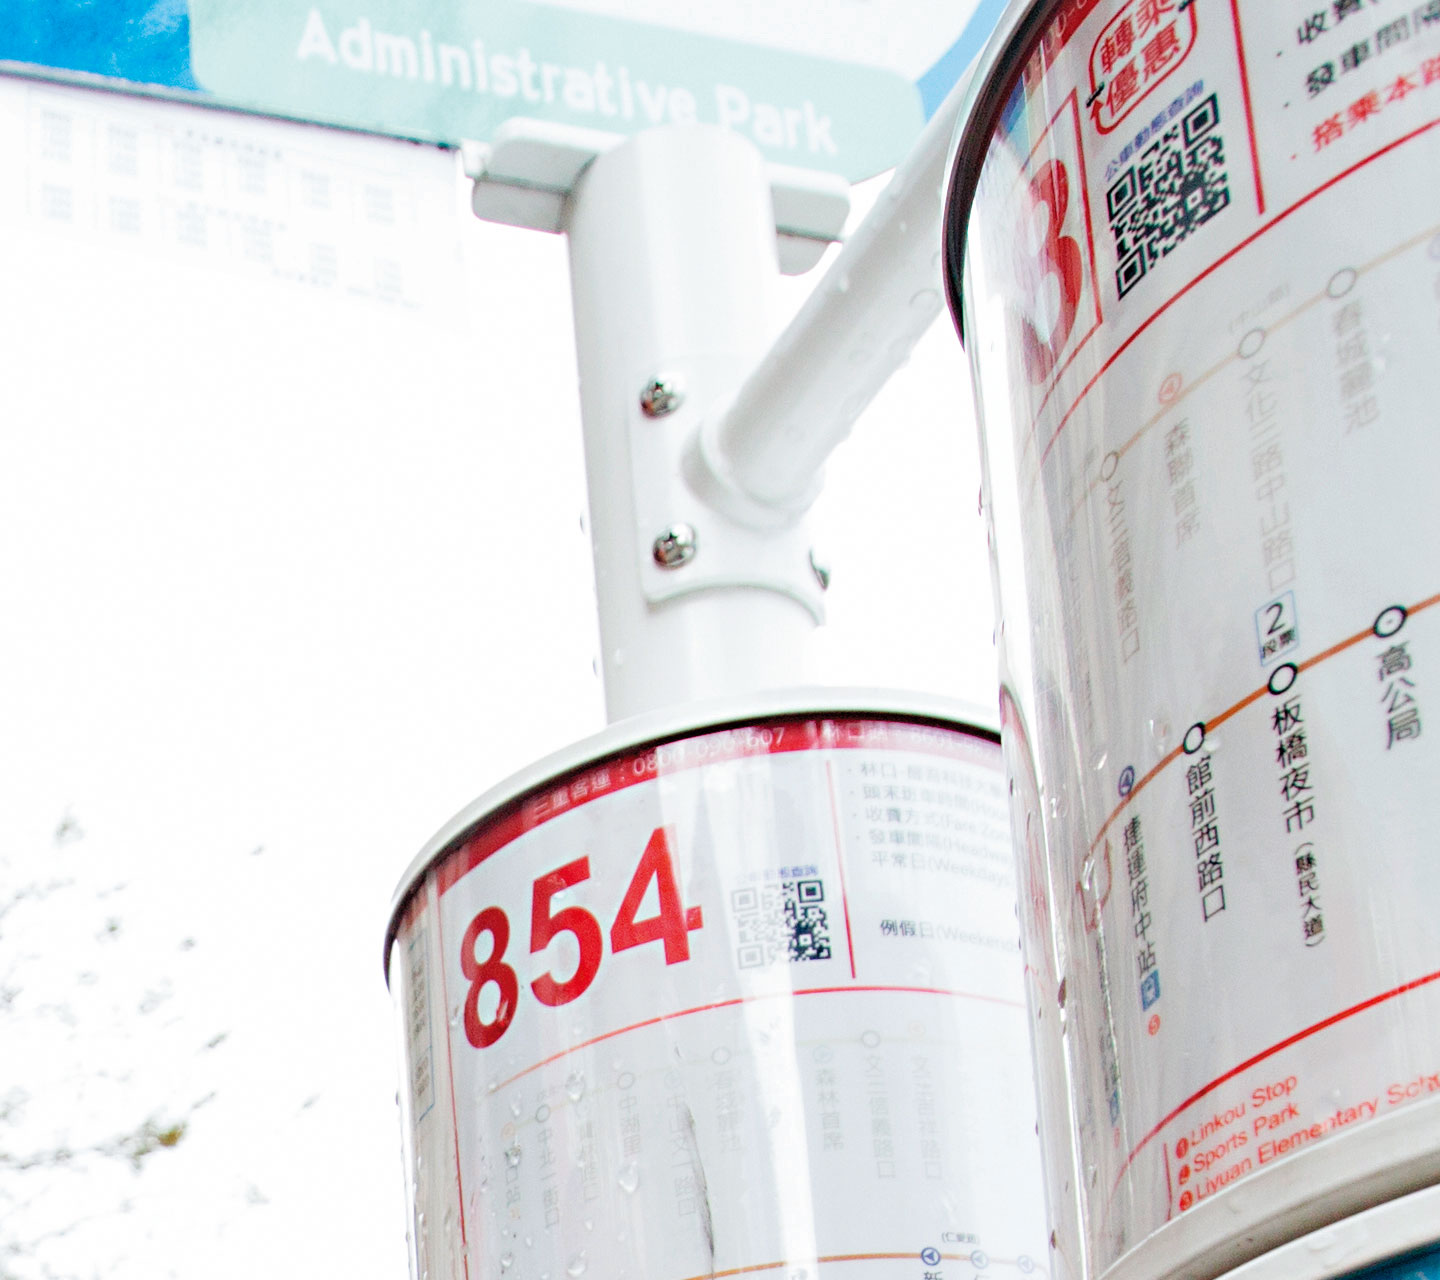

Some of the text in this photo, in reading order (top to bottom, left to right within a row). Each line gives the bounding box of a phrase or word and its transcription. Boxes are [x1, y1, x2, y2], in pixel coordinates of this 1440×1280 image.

[296, 6, 842, 157] Administrative Park
[1264, 601, 1288, 637] 2
[1372, 640, 1424, 752] 高公局
[1269, 693, 1317, 836] 板橋夜市
[1122, 815, 1158, 979] 捷運府中站
[1184, 755, 1228, 924] 館前西路口
[459, 823, 705, 1052] 854
[1188, 1072, 1299, 1146] Linkou Stop
[1192, 1101, 1301, 1174] Sports Park
[1257, 1097, 1379, 1166] Elementary
